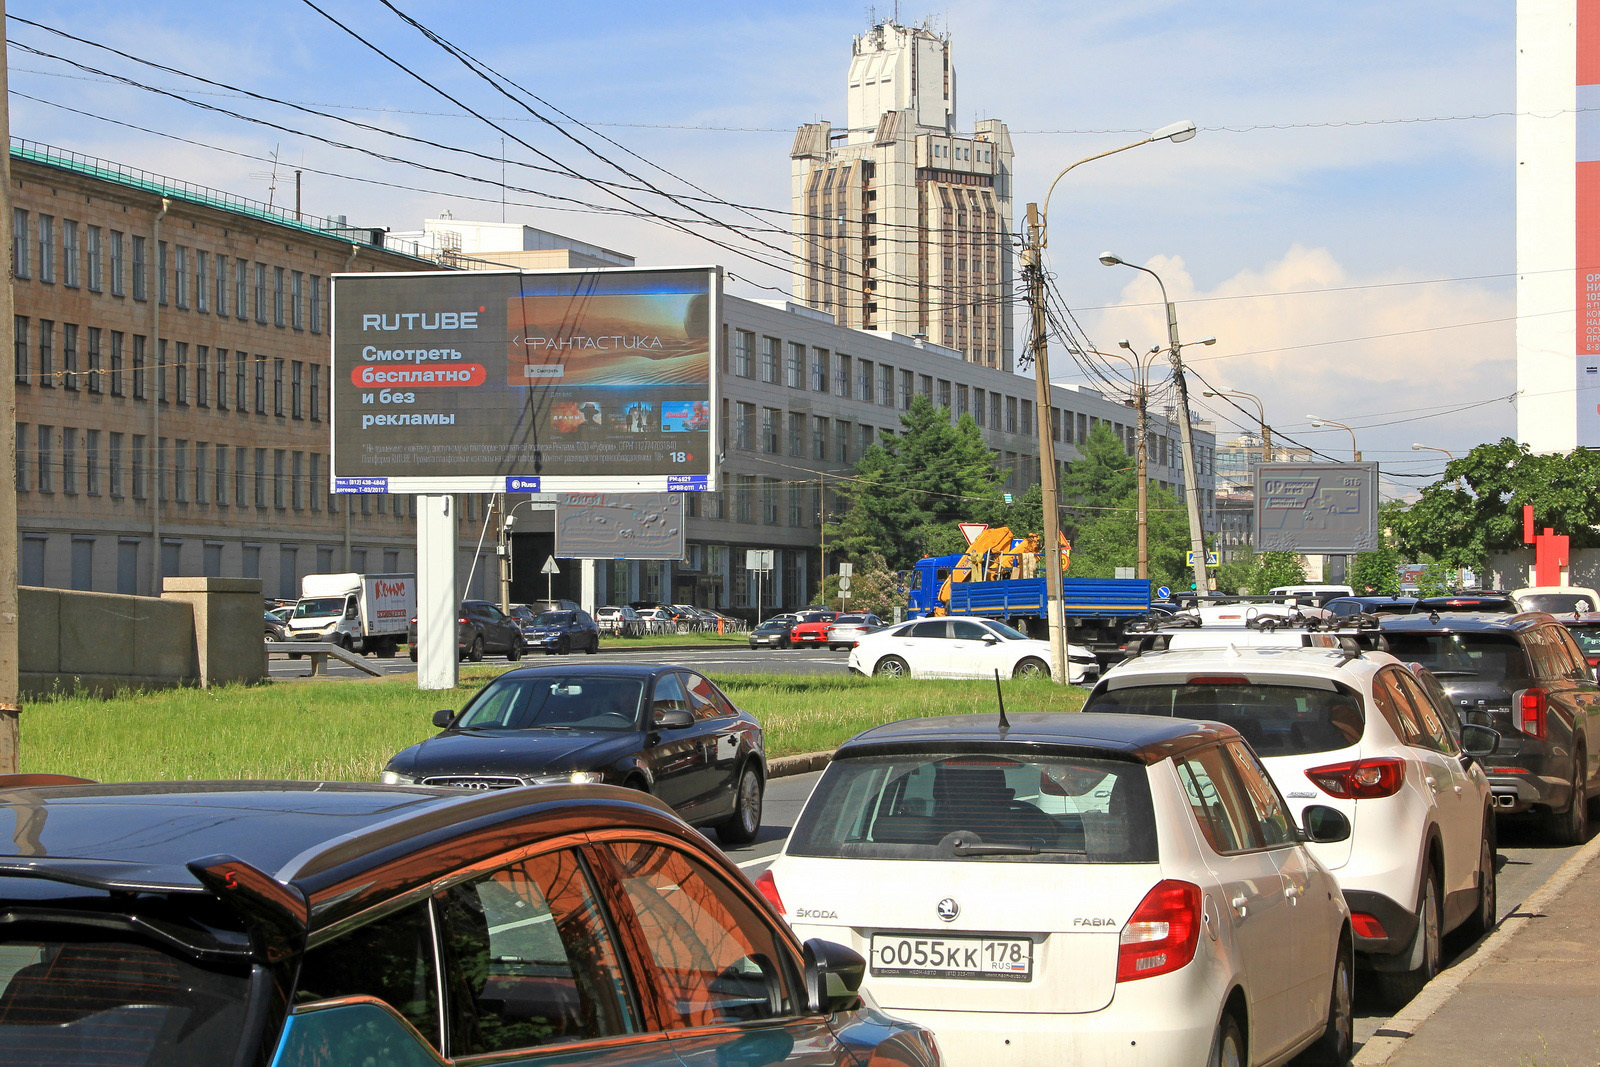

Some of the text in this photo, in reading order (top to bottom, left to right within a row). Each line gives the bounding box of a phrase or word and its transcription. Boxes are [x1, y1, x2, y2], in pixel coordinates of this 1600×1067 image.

[363, 312, 478, 331] RUTUBE
[524, 335, 663, 350] ФАНТАСТИКА
[362, 345, 462, 364] Смотреть
[362, 388, 415, 404] и без
[362, 413, 455, 430] рекламы
[1073, 918, 1116, 927] FABIA
[985, 942, 1022, 963] 178
[991, 962, 1011, 970] RUS
